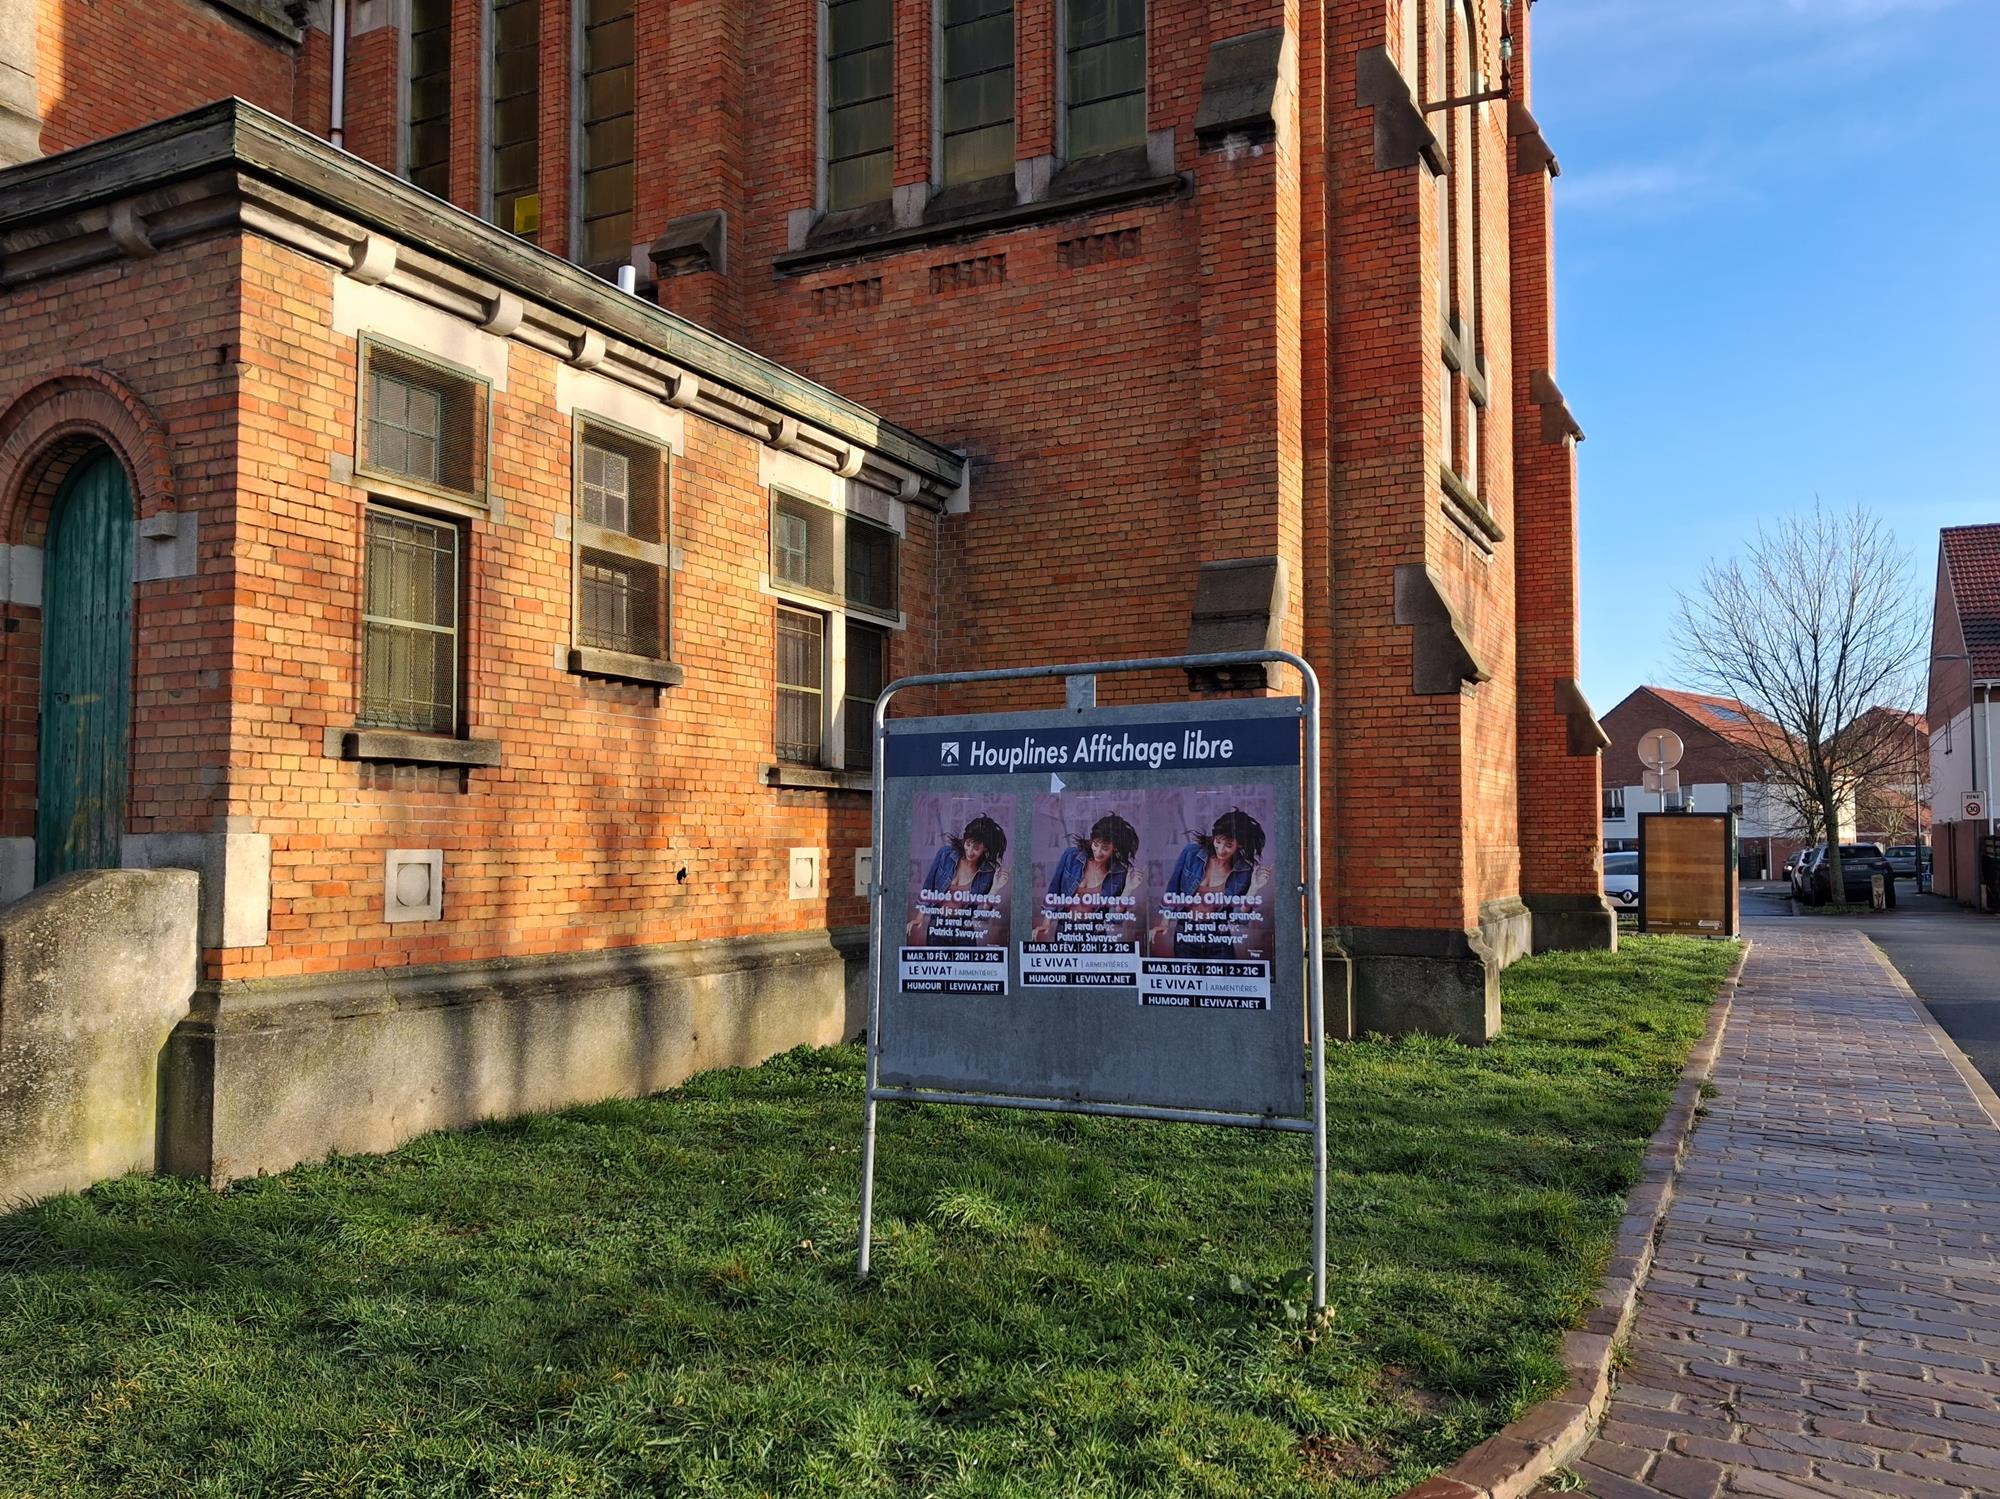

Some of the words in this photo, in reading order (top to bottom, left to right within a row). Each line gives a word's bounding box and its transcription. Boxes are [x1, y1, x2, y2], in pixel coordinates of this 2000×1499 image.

[970, 737, 1068, 772] Houplines
[1072, 734, 1177, 768] Affichage
[1182, 730, 1233, 759] libre
[920, 889, 951, 900] Chloé
[954, 891, 1002, 903] Oliveres
[1045, 894, 1080, 904] Chloé
[1082, 894, 1135, 905] Oliveres
[1163, 892, 1201, 904] Chloé
[1204, 892, 1262, 905] Oliveres
[945, 907, 953, 916] je
[954, 908, 971, 916] serai
[974, 910, 1002, 919] grande,
[1074, 911, 1082, 921] je
[1084, 911, 1103, 919] serai
[1105, 912, 1136, 922] grande,
[1194, 912, 1202, 921] je
[1206, 912, 1227, 920] serai
[1229, 912, 1263, 922] grande,
[936, 917, 943, 926] je
[945, 918, 962, 926] serai
[1064, 922, 1073, 931] je
[1074, 922, 1093, 931] serai
[929, 928, 953, 936] Patrick
[1184, 923, 1192, 932] je
[1196, 923, 1216, 932] serai
[1057, 933, 1083, 941] Patrick
[1176, 933, 1206, 943] Patrick
[1029, 944, 1048, 952] MAR.
[1050, 944, 1058, 952] 10
[1060, 943, 1076, 952] FÉV.
[1081, 944, 1097, 952] 20H
[1103, 944, 1107, 952] 2
[907, 952, 925, 960] MAR.
[926, 952, 934, 960] 10
[935, 951, 951, 960] FÉV.
[955, 953, 970, 961] 20H
[975, 953, 978, 961] 2
[1031, 958, 1041, 967] LE
[1044, 958, 1078, 967] VIVAT
[909, 966, 919, 975] LE
[921, 966, 952, 975] VIVAT
[1148, 964, 1170, 973] MAR.
[1171, 964, 1180, 973] 10
[1182, 963, 1200, 974] FÉV.
[1206, 966, 1223, 974] 20H
[1230, 967, 1234, 975] 2
[1029, 975, 1067, 983] HUMOUR
[1076, 975, 1131, 984] LEVIVAT.NET
[1151, 979, 1162, 988] LE
[1166, 980, 1202, 990] VIVAT
[907, 982, 941, 990] HUMOUR
[949, 983, 999, 991] LEVIVAT.NET
[1148, 996, 1190, 1006] HUMOUR
[1200, 999, 1260, 1008] LEVIVAT.NET
